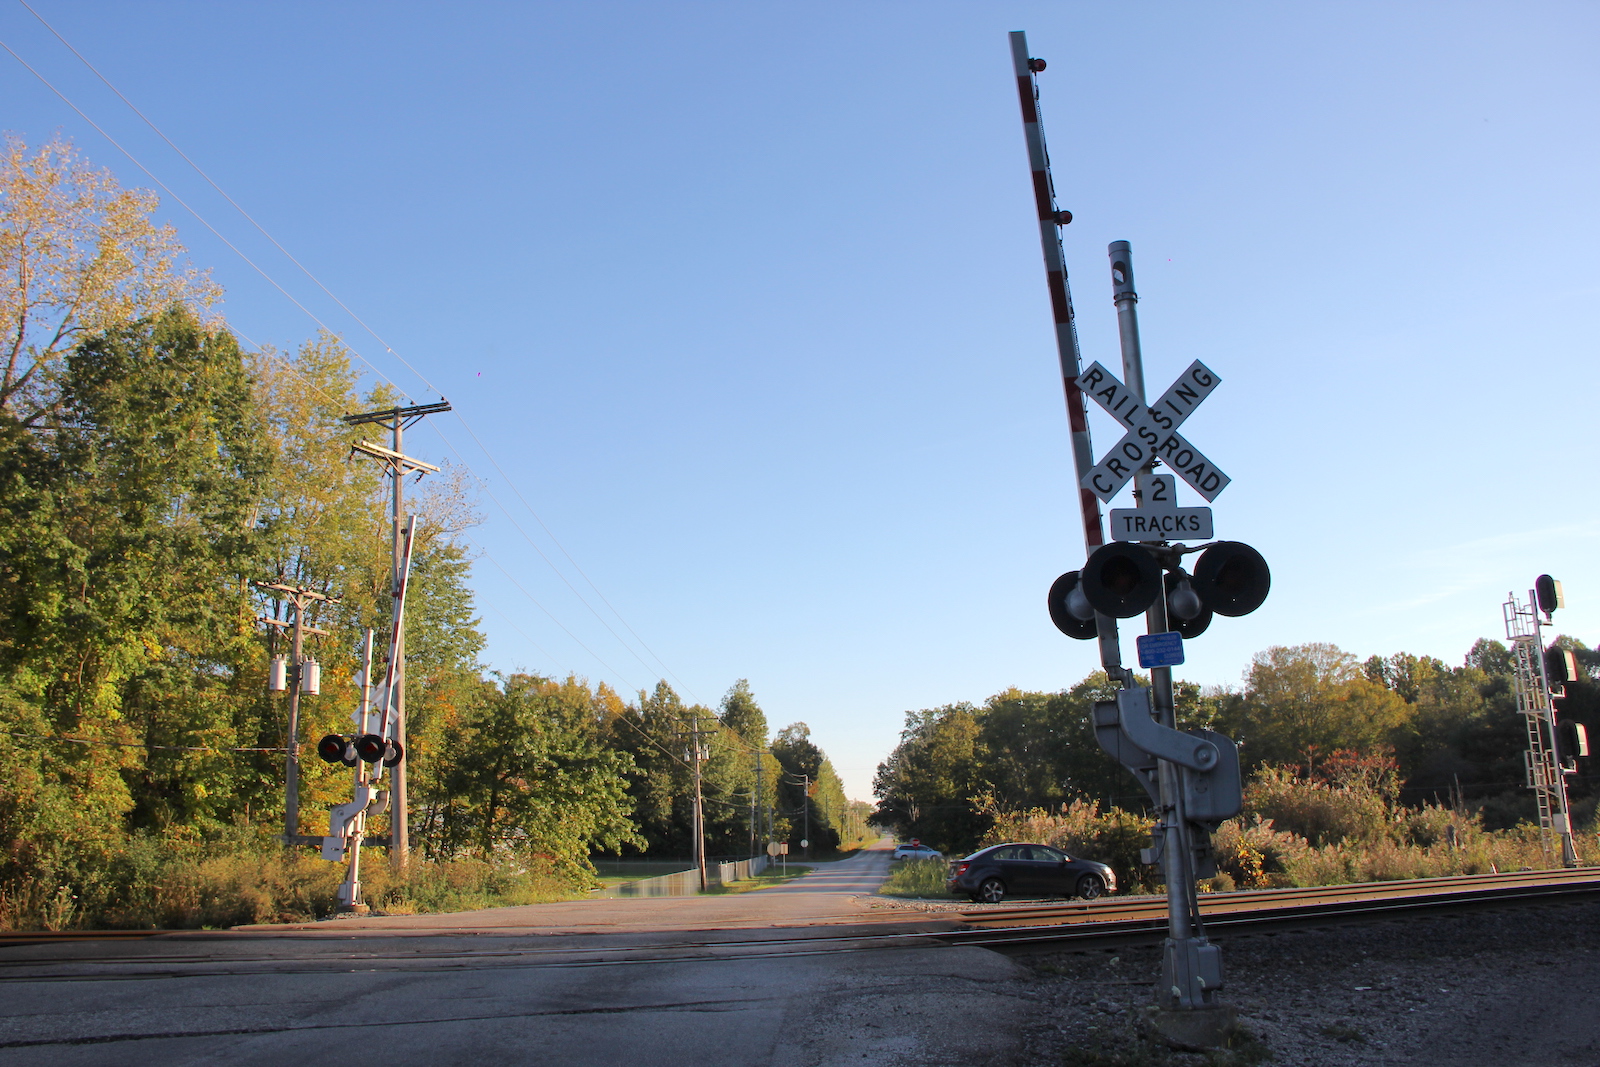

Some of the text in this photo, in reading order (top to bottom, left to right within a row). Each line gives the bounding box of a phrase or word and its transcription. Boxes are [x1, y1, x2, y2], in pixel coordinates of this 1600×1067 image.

[1082, 368, 1220, 492] RAIL ROAD
[1092, 368, 1212, 494] CROSSING
[1123, 515, 1200, 532] TRACKS
[1151, 480, 1167, 501] 2
